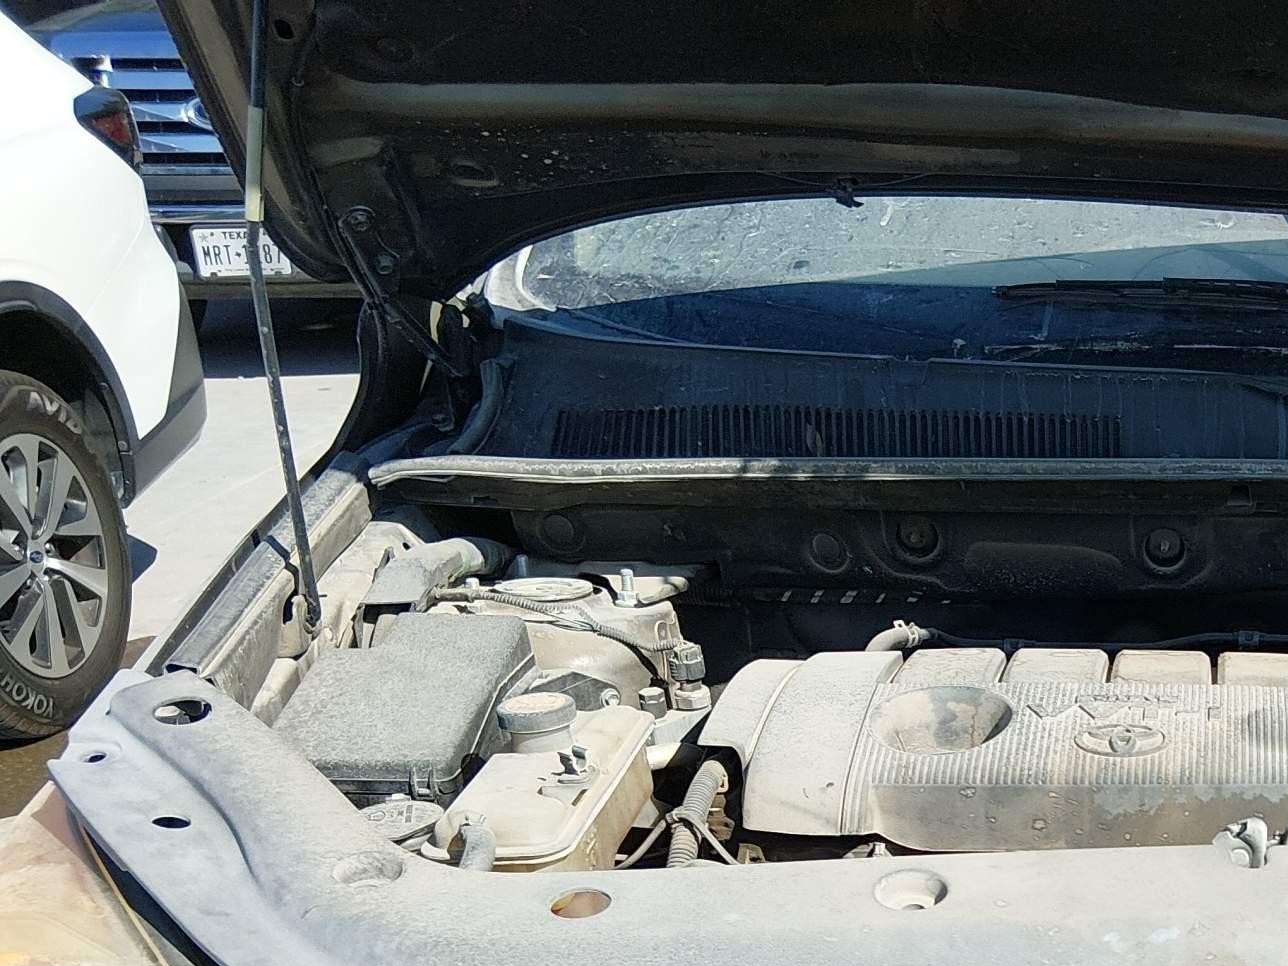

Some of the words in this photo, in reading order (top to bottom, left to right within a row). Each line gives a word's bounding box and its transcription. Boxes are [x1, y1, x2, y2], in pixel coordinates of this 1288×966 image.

[221, 231, 249, 240] TEXA
[202, 244, 231, 266] MRT
[241, 243, 282, 265] 187
